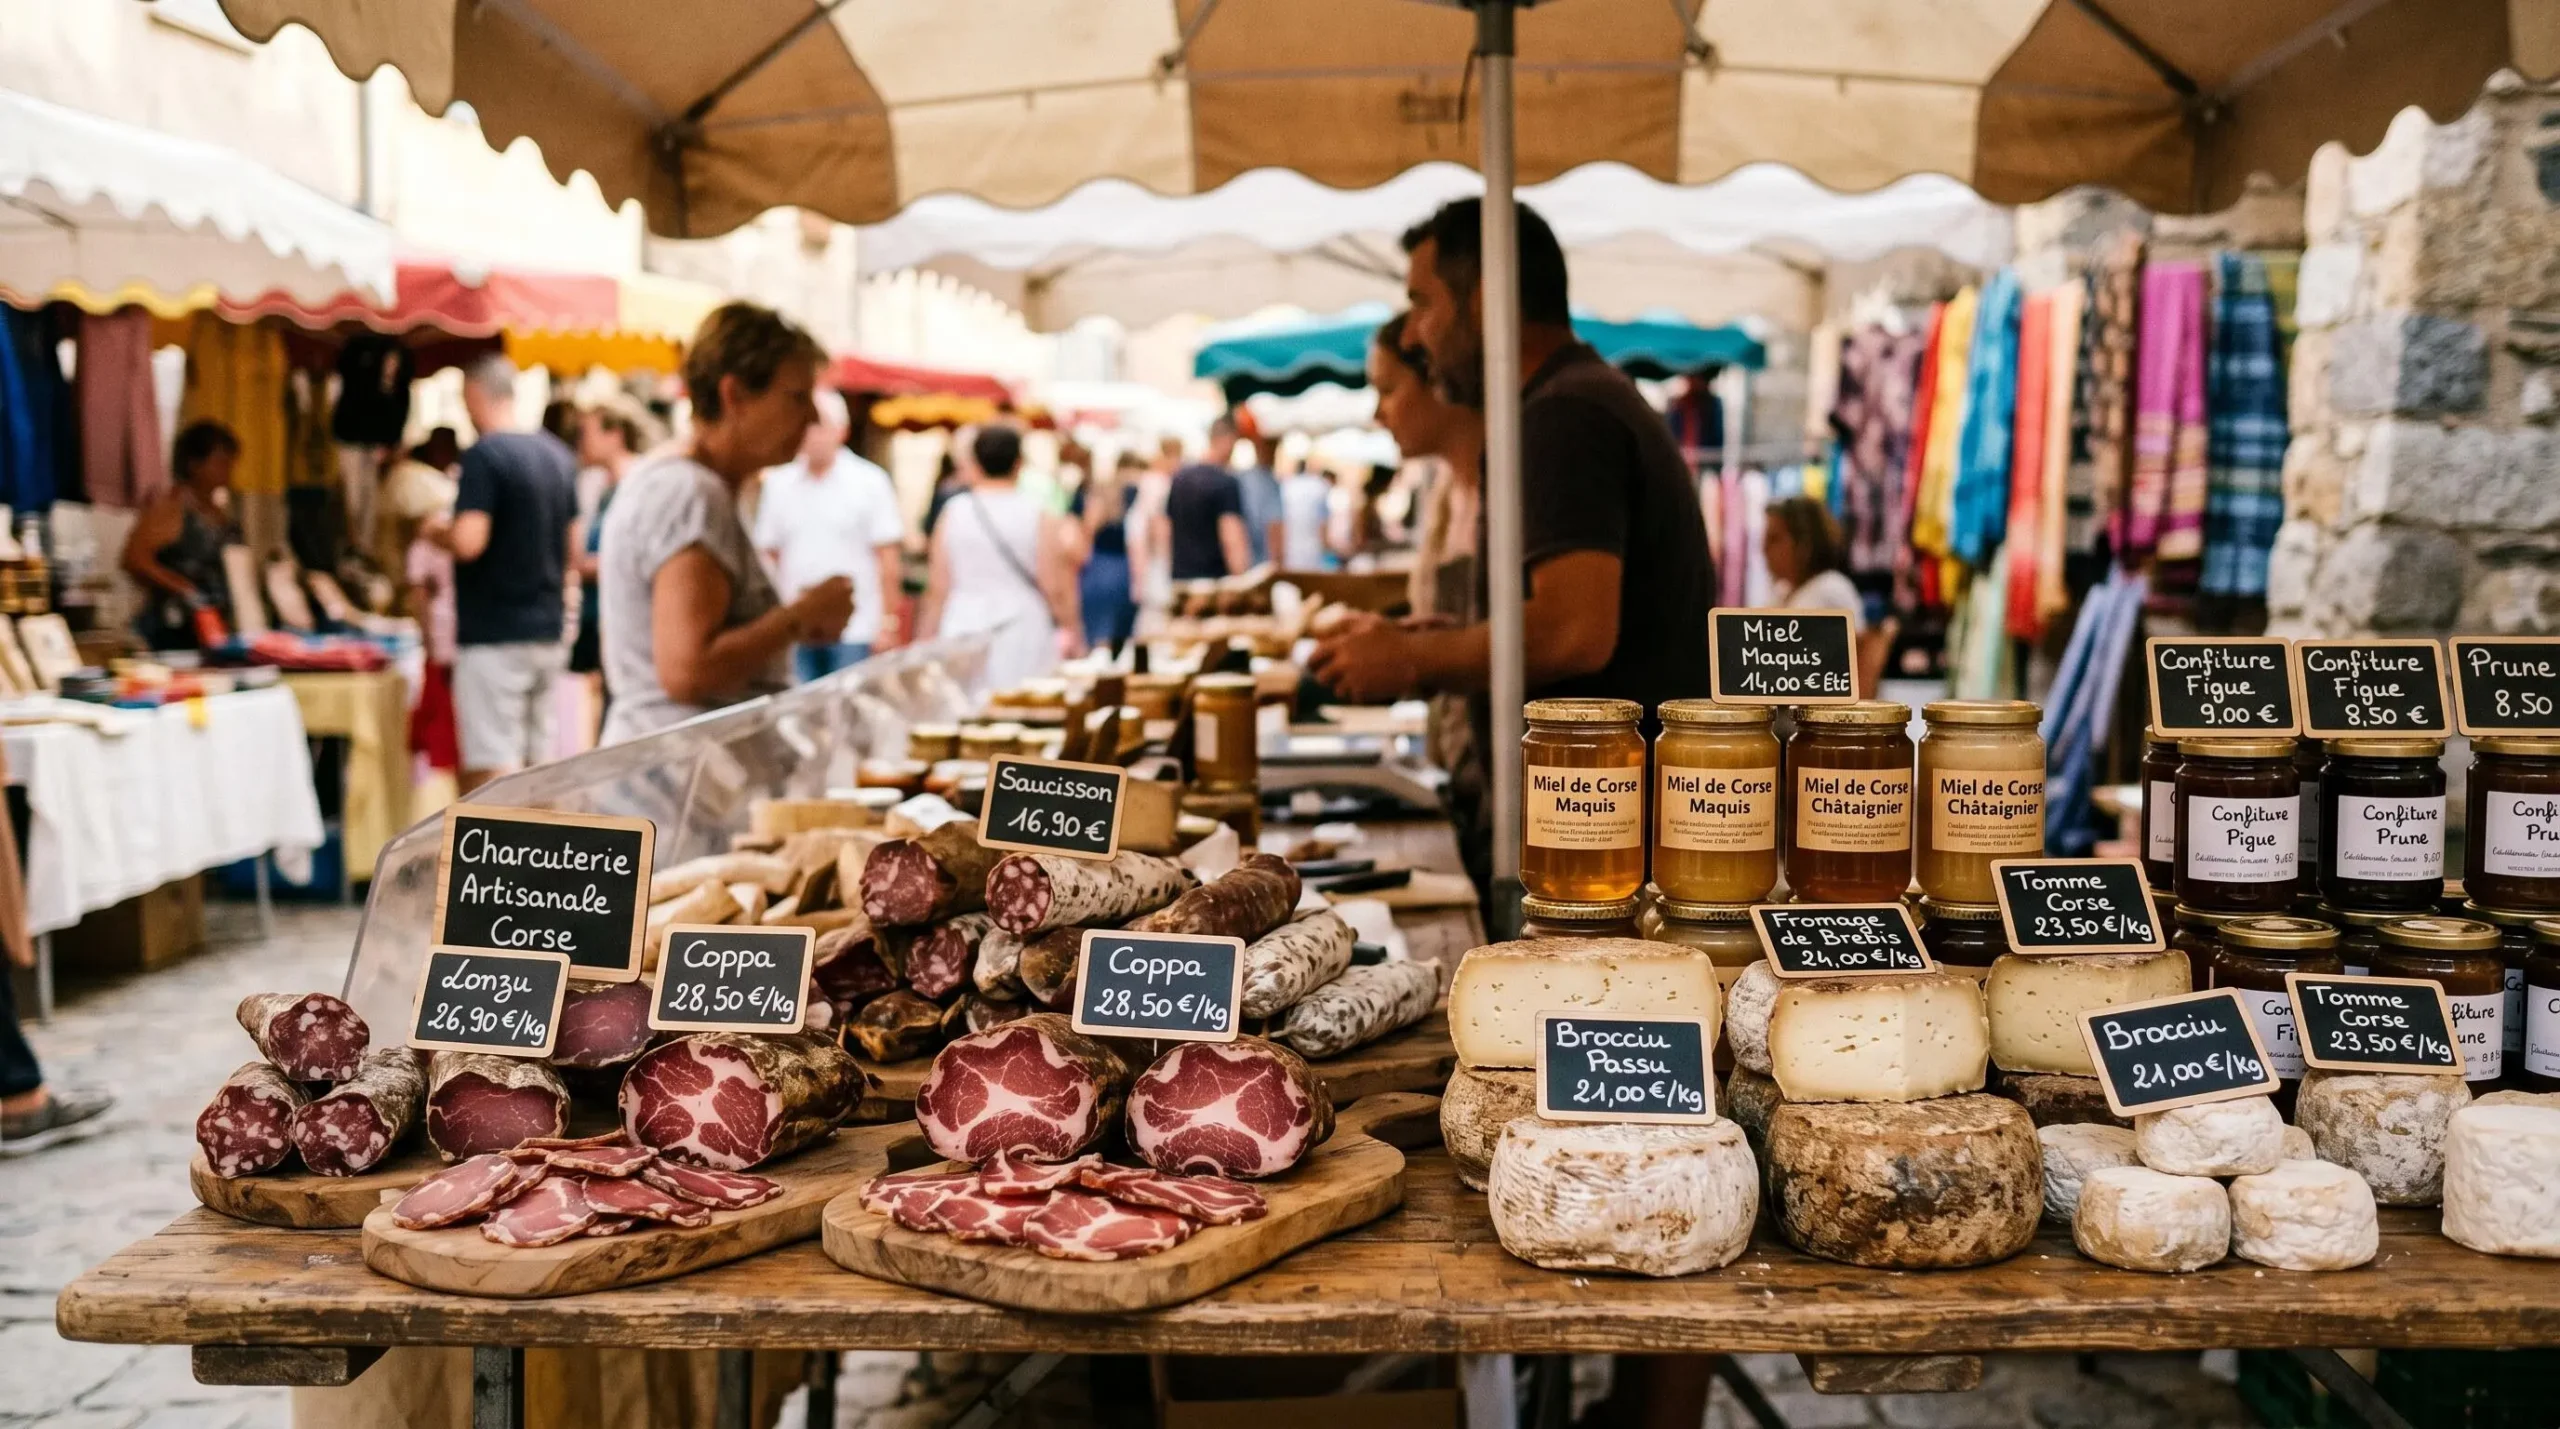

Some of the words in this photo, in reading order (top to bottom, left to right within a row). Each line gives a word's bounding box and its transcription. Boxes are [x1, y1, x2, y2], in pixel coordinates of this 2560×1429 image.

[1744, 620, 1802, 642] Miel
[1742, 647, 1822, 671] Maquis
[2160, 648, 2275, 676] Confiture
[2307, 650, 2424, 678] Confiture
[2468, 648, 2556, 677] Prune
[2186, 675, 2256, 703] Figue
[2334, 678, 2405, 705] Figue
[2257, 704, 2279, 723] €
[2345, 704, 2397, 727] 8,50
[2407, 706, 2429, 724] €
[2495, 690, 2553, 718] 8,50
[999, 766, 1113, 802] Saucisson
[1534, 775, 1565, 792] Miel
[1570, 777, 1592, 793] de
[1597, 778, 1637, 793] Corse
[1668, 776, 1699, 792] Miel
[1705, 778, 1726, 794] de
[1731, 779, 1772, 794] Corse
[1805, 777, 1838, 794] Miel
[1845, 779, 1865, 795] de
[1871, 780, 1909, 795] Corse
[1941, 778, 1977, 795] Miel
[1983, 780, 2003, 795] de
[2008, 780, 2043, 795] Corse
[1556, 798, 1616, 817] Maquis
[1690, 799, 1750, 818] Maquis
[1812, 798, 1903, 819] Châtaignier
[1948, 799, 2038, 819] Châtaignier
[2212, 805, 2289, 828] Confiture
[2364, 804, 2438, 828] Confiture
[2513, 801, 2558, 823] Confi
[1008, 808, 1080, 837] 16,90
[2526, 824, 2560, 841] Pru
[2227, 829, 2277, 852] Pigue
[2377, 828, 2429, 845] Prune
[460, 829, 631, 876] Charcuterie
[2010, 870, 2107, 890] Tomme
[460, 873, 611, 915] Artisanale
[2047, 893, 2115, 912] Corse
[491, 916, 577, 951] Corse
[1772, 912, 1886, 934] Fromage
[1781, 930, 1812, 946] de
[1819, 929, 1902, 946] Brebis
[684, 940, 776, 978] Coppa
[1109, 946, 1206, 985] Coppa
[442, 959, 533, 1003] Lonzu
[2306, 986, 2410, 1009] Tomme
[2340, 1009, 2410, 1029] Corse
[2451, 1003, 2495, 1028] fiture
[1556, 1021, 1671, 1048] Brocciu
[2103, 1014, 2227, 1050] Brocciu
[2457, 1033, 2486, 1044] une
[1586, 1049, 1671, 1074] Passu
